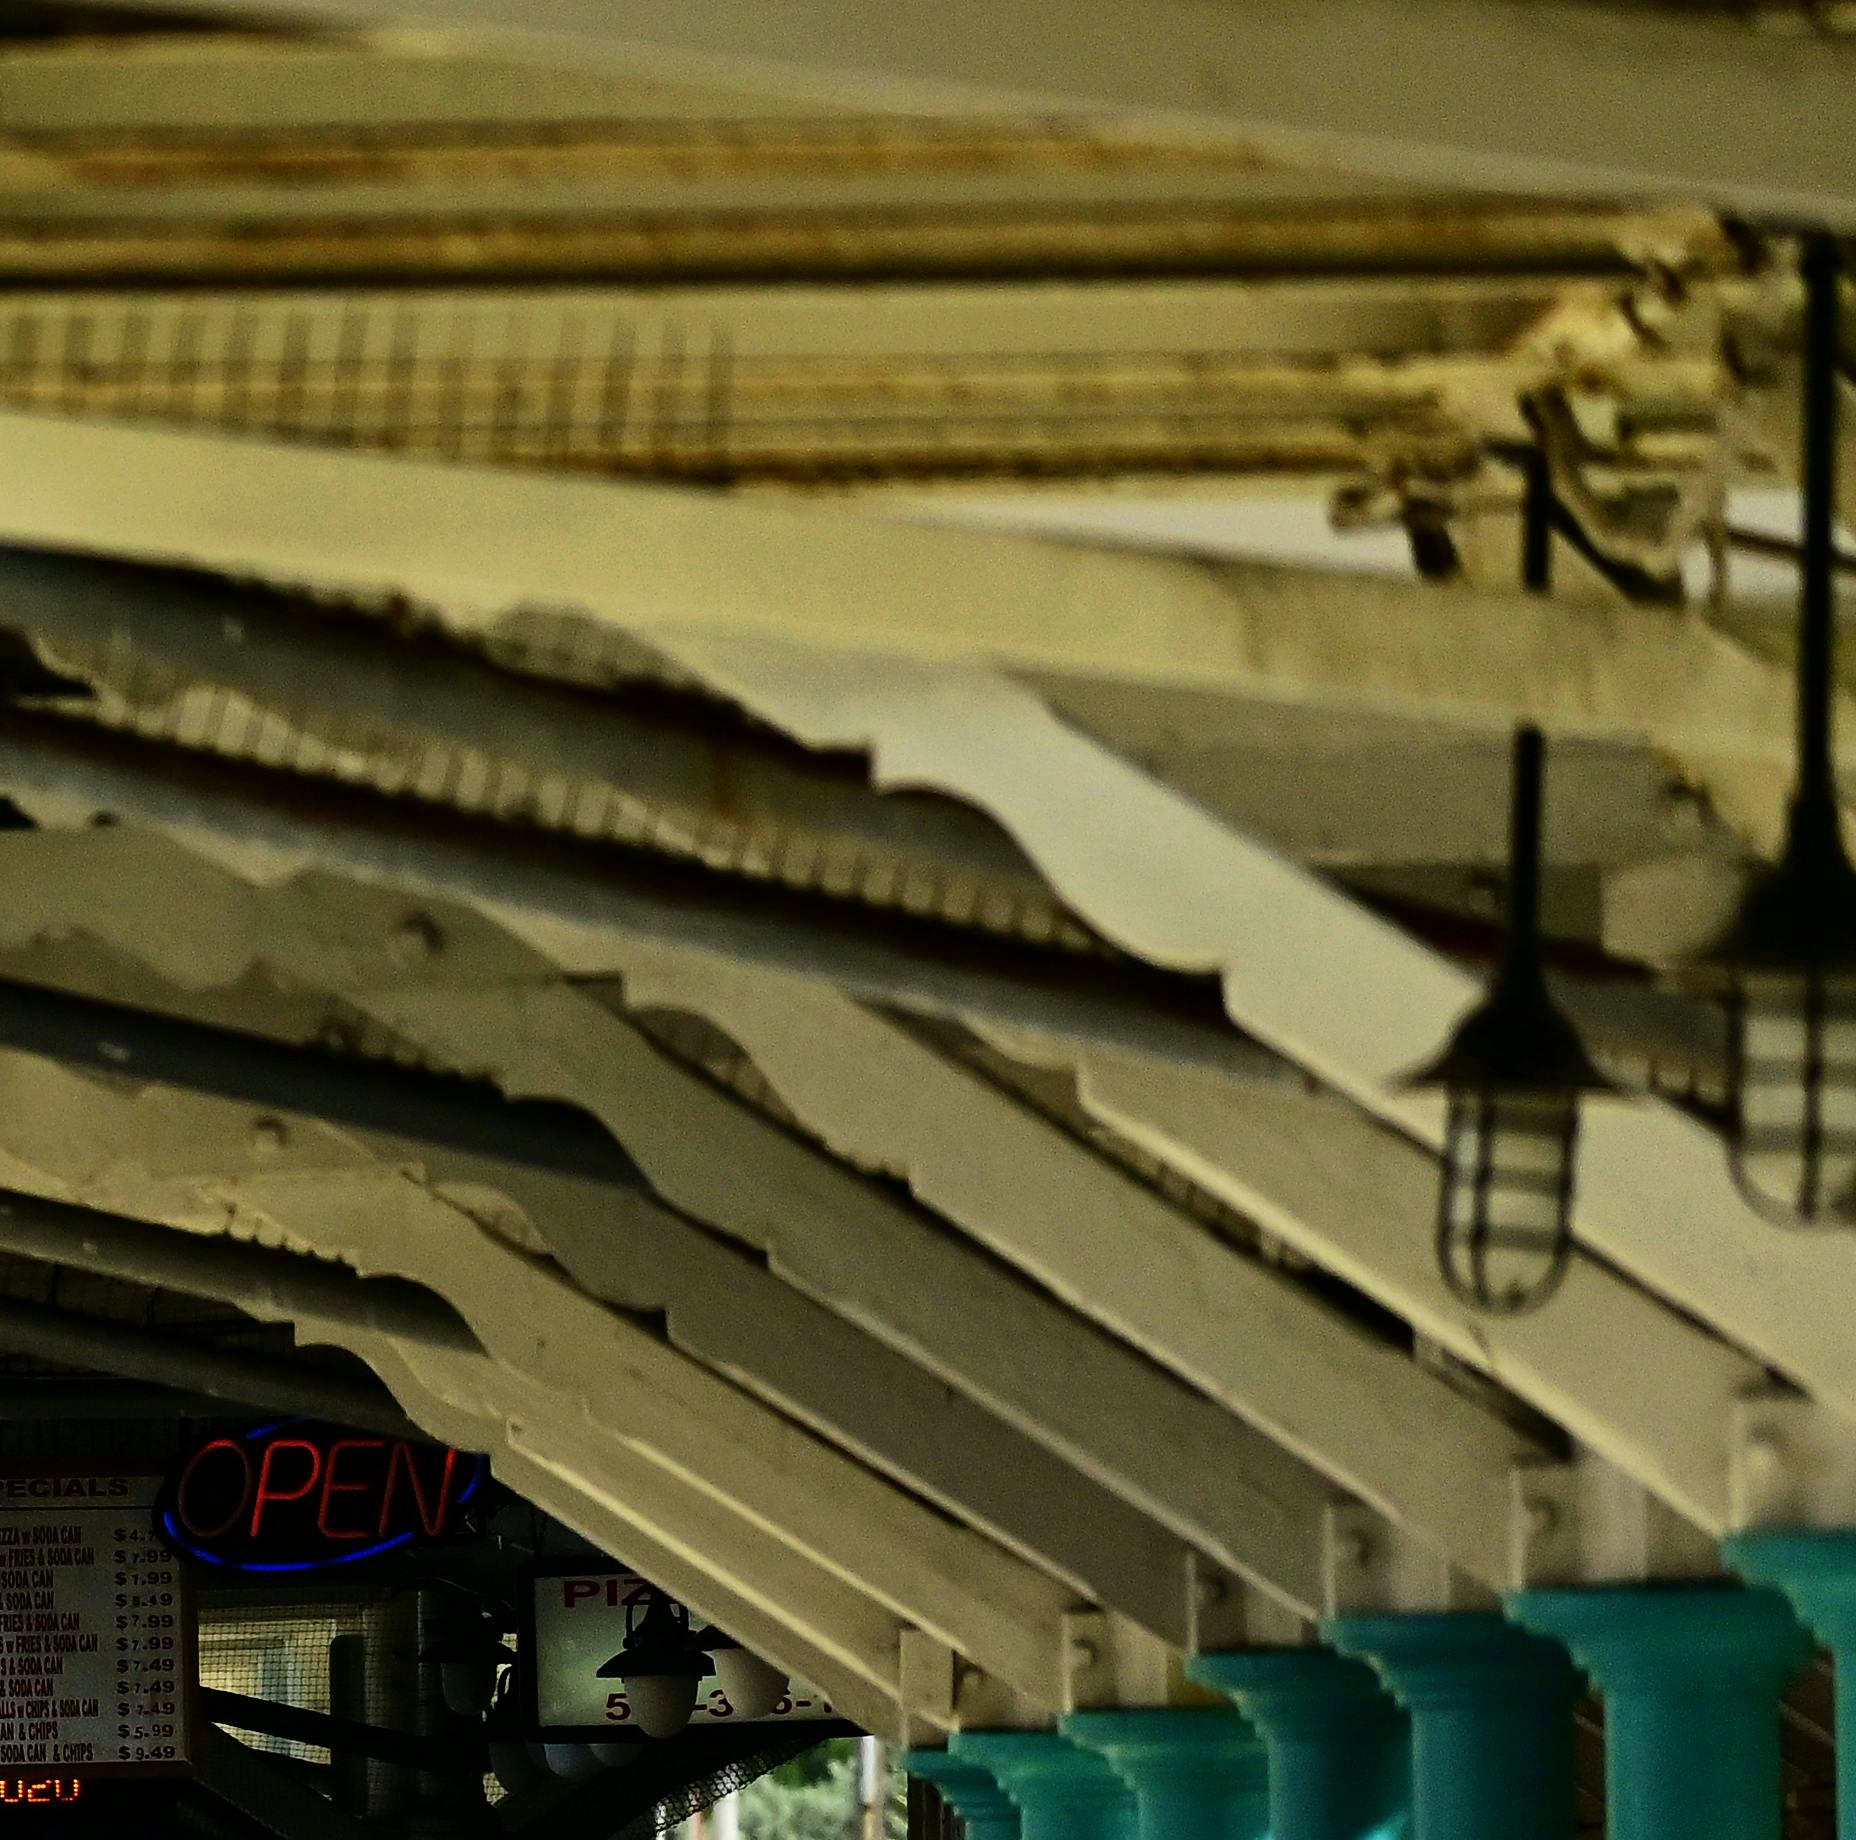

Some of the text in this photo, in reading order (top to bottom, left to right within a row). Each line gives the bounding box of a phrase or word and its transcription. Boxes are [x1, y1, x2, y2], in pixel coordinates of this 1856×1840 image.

[179, 1437, 457, 1540] OPEN
[33, 1527, 59, 1545] SODA
[61, 1526, 81, 1544] CAN
[114, 1529, 125, 1543] $
[9, 1549, 35, 1567] FRIES
[47, 1548, 72, 1566] SODA
[73, 1548, 94, 1565] CAN
[114, 1551, 126, 1564] $
[1, 1570, 29, 1588] SODA
[32, 1570, 53, 1588] CAN
[115, 1573, 127, 1585] $
[6, 1593, 32, 1610] SODA
[35, 1592, 54, 1609] CAN
[115, 1594, 127, 1607] $
[35, 1614, 58, 1631] SODA
[61, 1613, 80, 1630] CAN
[116, 1616, 127, 1628] $
[132, 1615, 173, 1628] 7.99
[16, 1635, 41, 1653] FRIES
[53, 1635, 77, 1653] SODA
[79, 1634, 98, 1651] CAN
[116, 1637, 128, 1651] $
[132, 1637, 174, 1650] 7.99
[18, 1657, 43, 1674] SODA
[46, 1657, 63, 1674] CAN
[117, 1659, 128, 1673] $
[133, 1658, 174, 1671] 7.49
[8, 1679, 33, 1696] SODA
[36, 1679, 53, 1696] CAN
[117, 1681, 129, 1694] $
[26, 1702, 50, 1718] CHIPS
[60, 1700, 80, 1717] SODA
[82, 1700, 99, 1717] CAN
[118, 1703, 130, 1716] $
[19, 1723, 25, 1740] &
[29, 1722, 58, 1740] CHIPS
[118, 1725, 130, 1738] $
[134, 1725, 174, 1739] 5.99
[1, 1744, 26, 1763] SODA
[27, 1744, 46, 1762] CAN
[53, 1744, 60, 1761] &
[63, 1743, 92, 1761] CHIPS
[119, 1747, 131, 1760] $
[136, 1746, 175, 1760] 9.49
